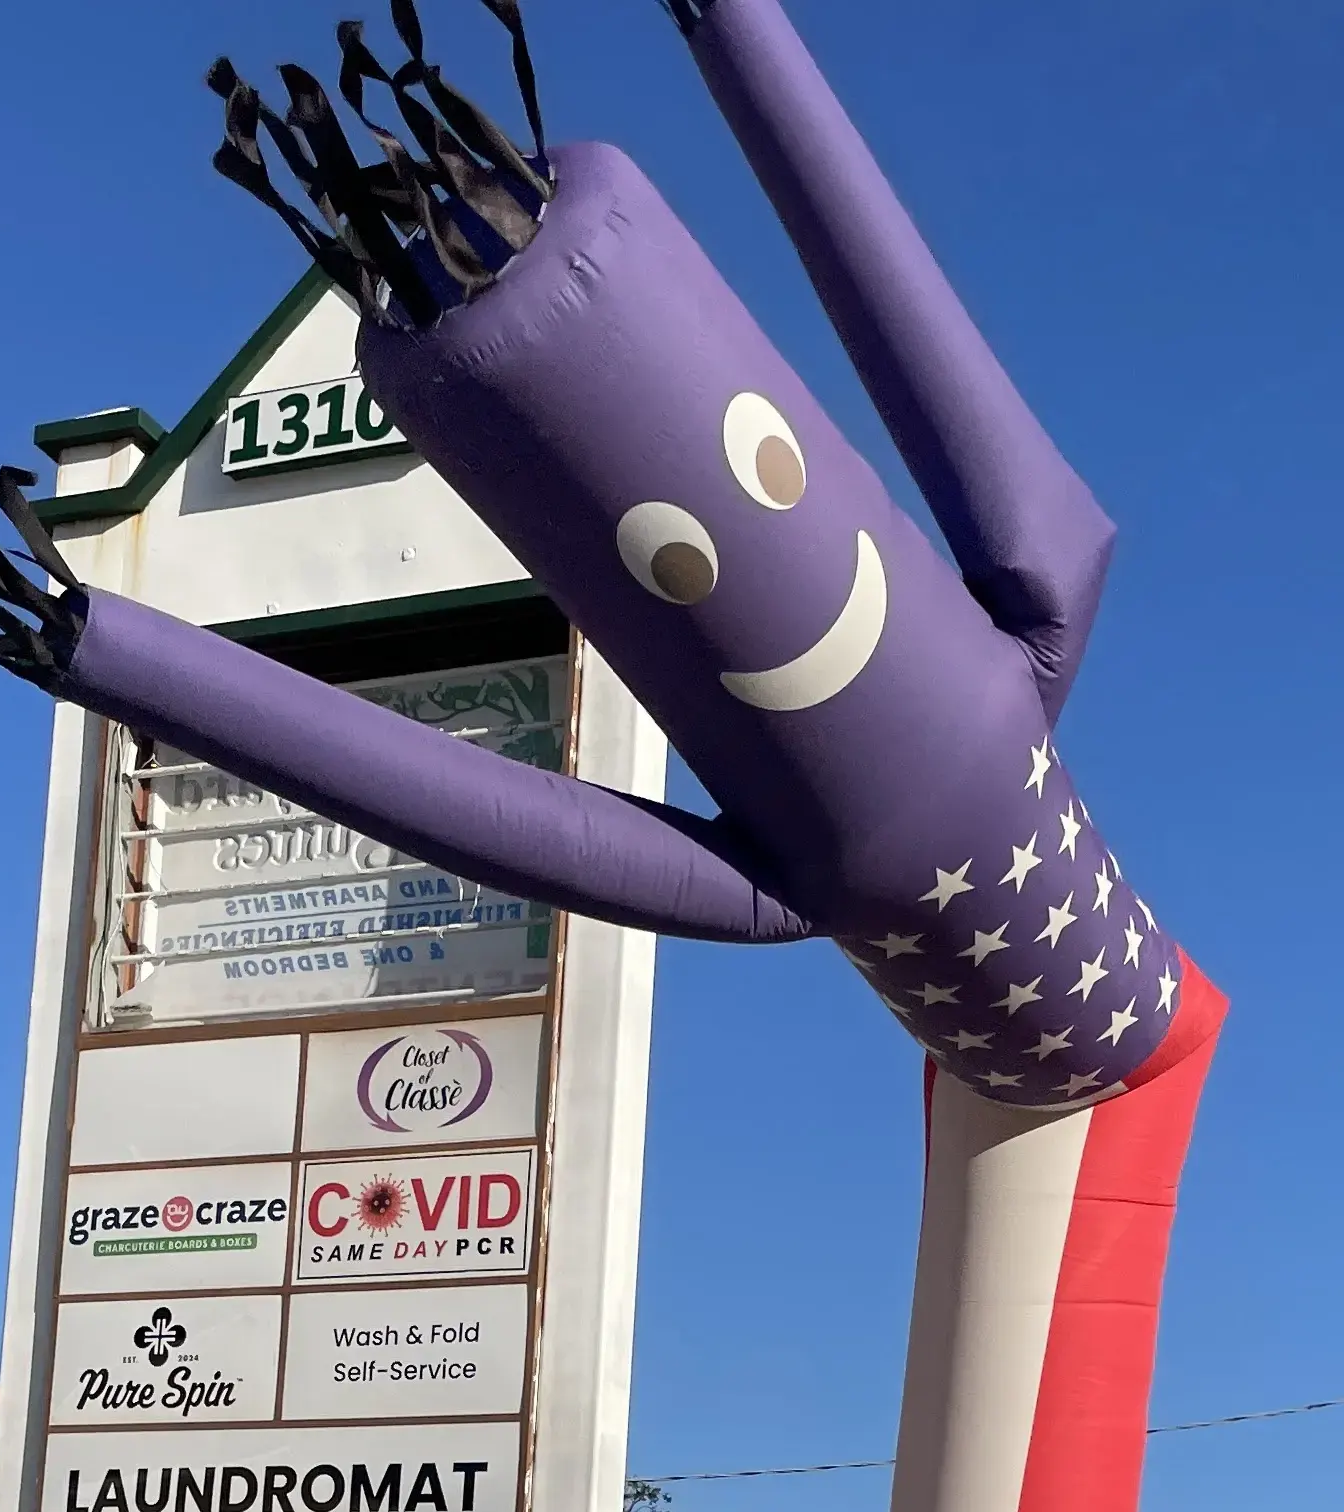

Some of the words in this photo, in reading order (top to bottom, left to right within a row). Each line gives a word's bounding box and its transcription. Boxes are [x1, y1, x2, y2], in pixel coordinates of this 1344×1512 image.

[402, 1045, 451, 1068] Closet
[418, 1068, 436, 1086] of
[69, 1204, 160, 1246] graze
[195, 1198, 288, 1226] craze
[98, 1239, 165, 1254] CHARCUTERIE
[168, 1238, 207, 1250] BOARDS
[210, 1237, 217, 1248] &
[220, 1236, 253, 1248] BOXES
[310, 1242, 385, 1263] SAME
[393, 1239, 448, 1260] DAY
[456, 1236, 515, 1256] PCR
[333, 1324, 399, 1348] Wash
[405, 1325, 423, 1345] &
[431, 1322, 480, 1344] Fold
[333, 1357, 477, 1383] Self-Service
[76, 1368, 156, 1411] Pure
[161, 1365, 236, 1417] Spin
